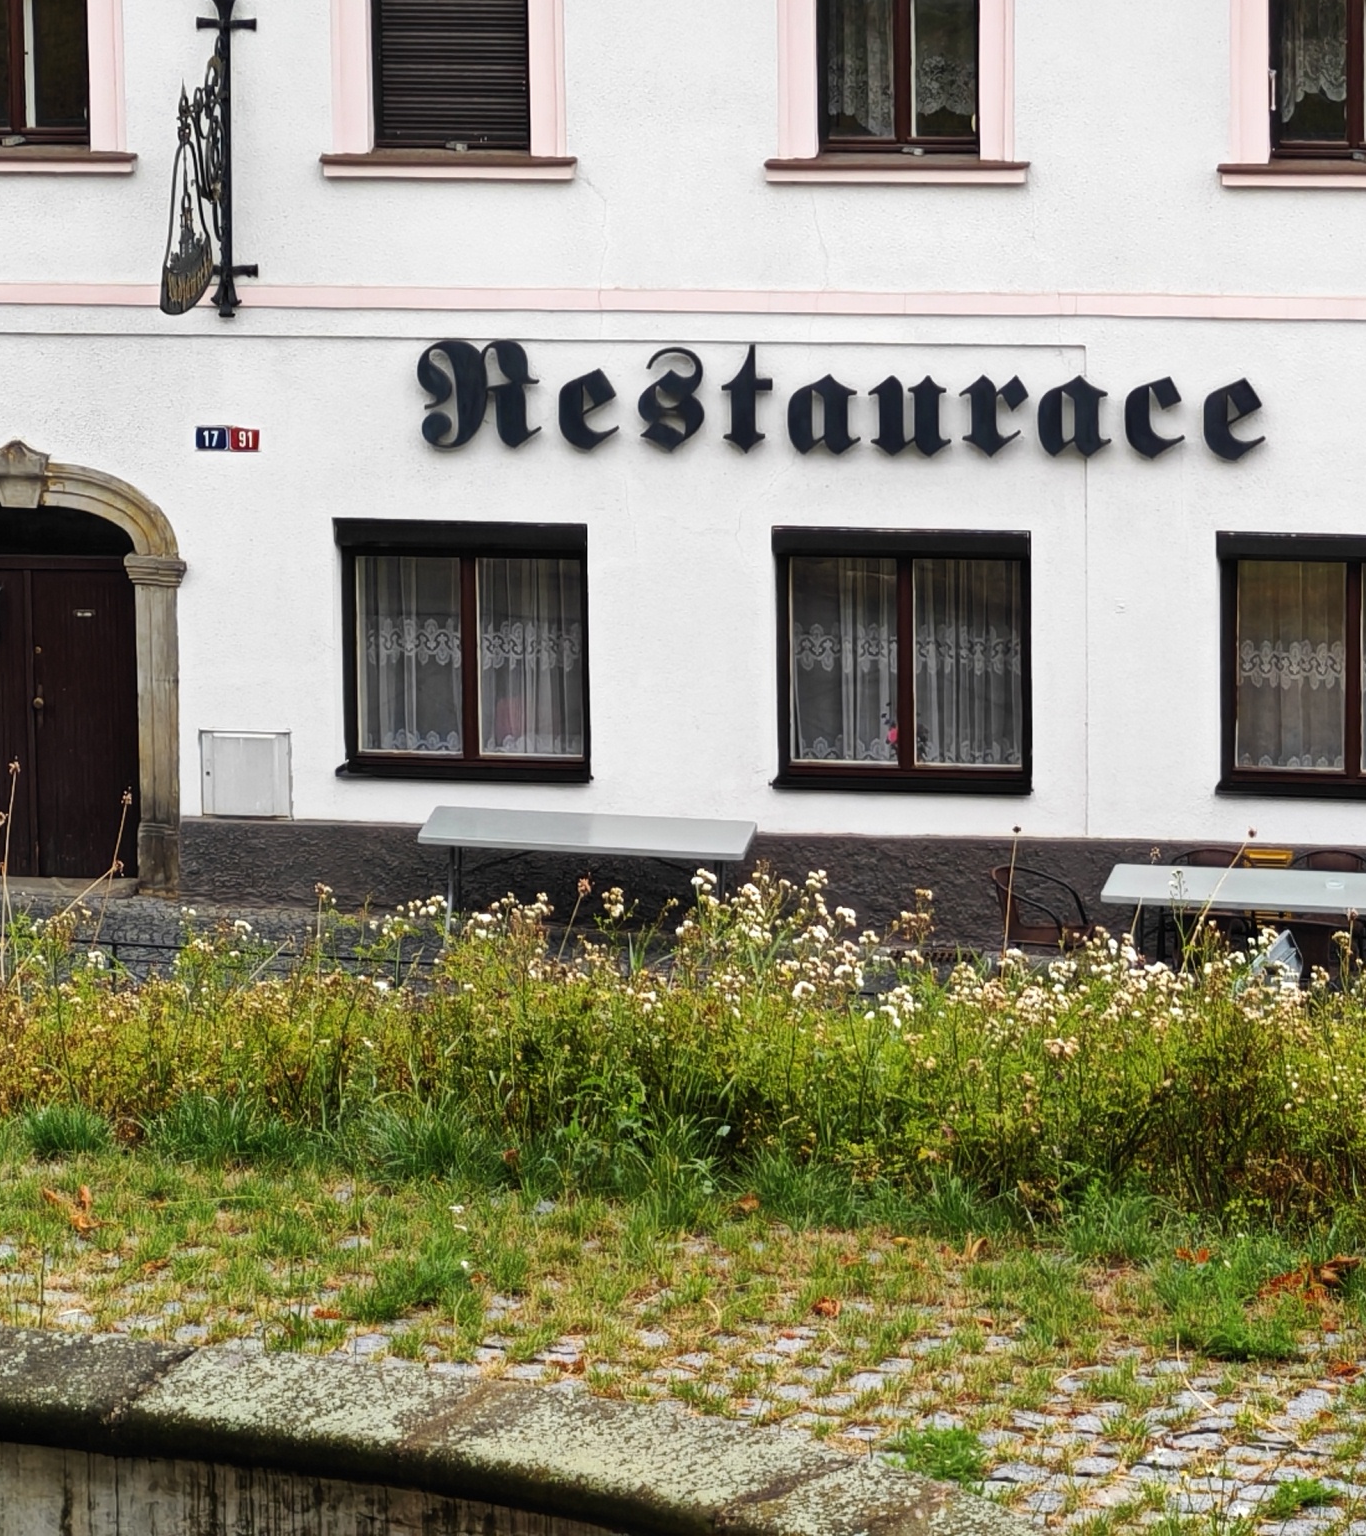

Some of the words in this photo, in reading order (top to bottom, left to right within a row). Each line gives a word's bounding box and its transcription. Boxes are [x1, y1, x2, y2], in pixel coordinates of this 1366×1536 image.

[416, 337, 1267, 464] Restaurace
[203, 430, 219, 447] 17
[238, 430, 253, 448] 91
